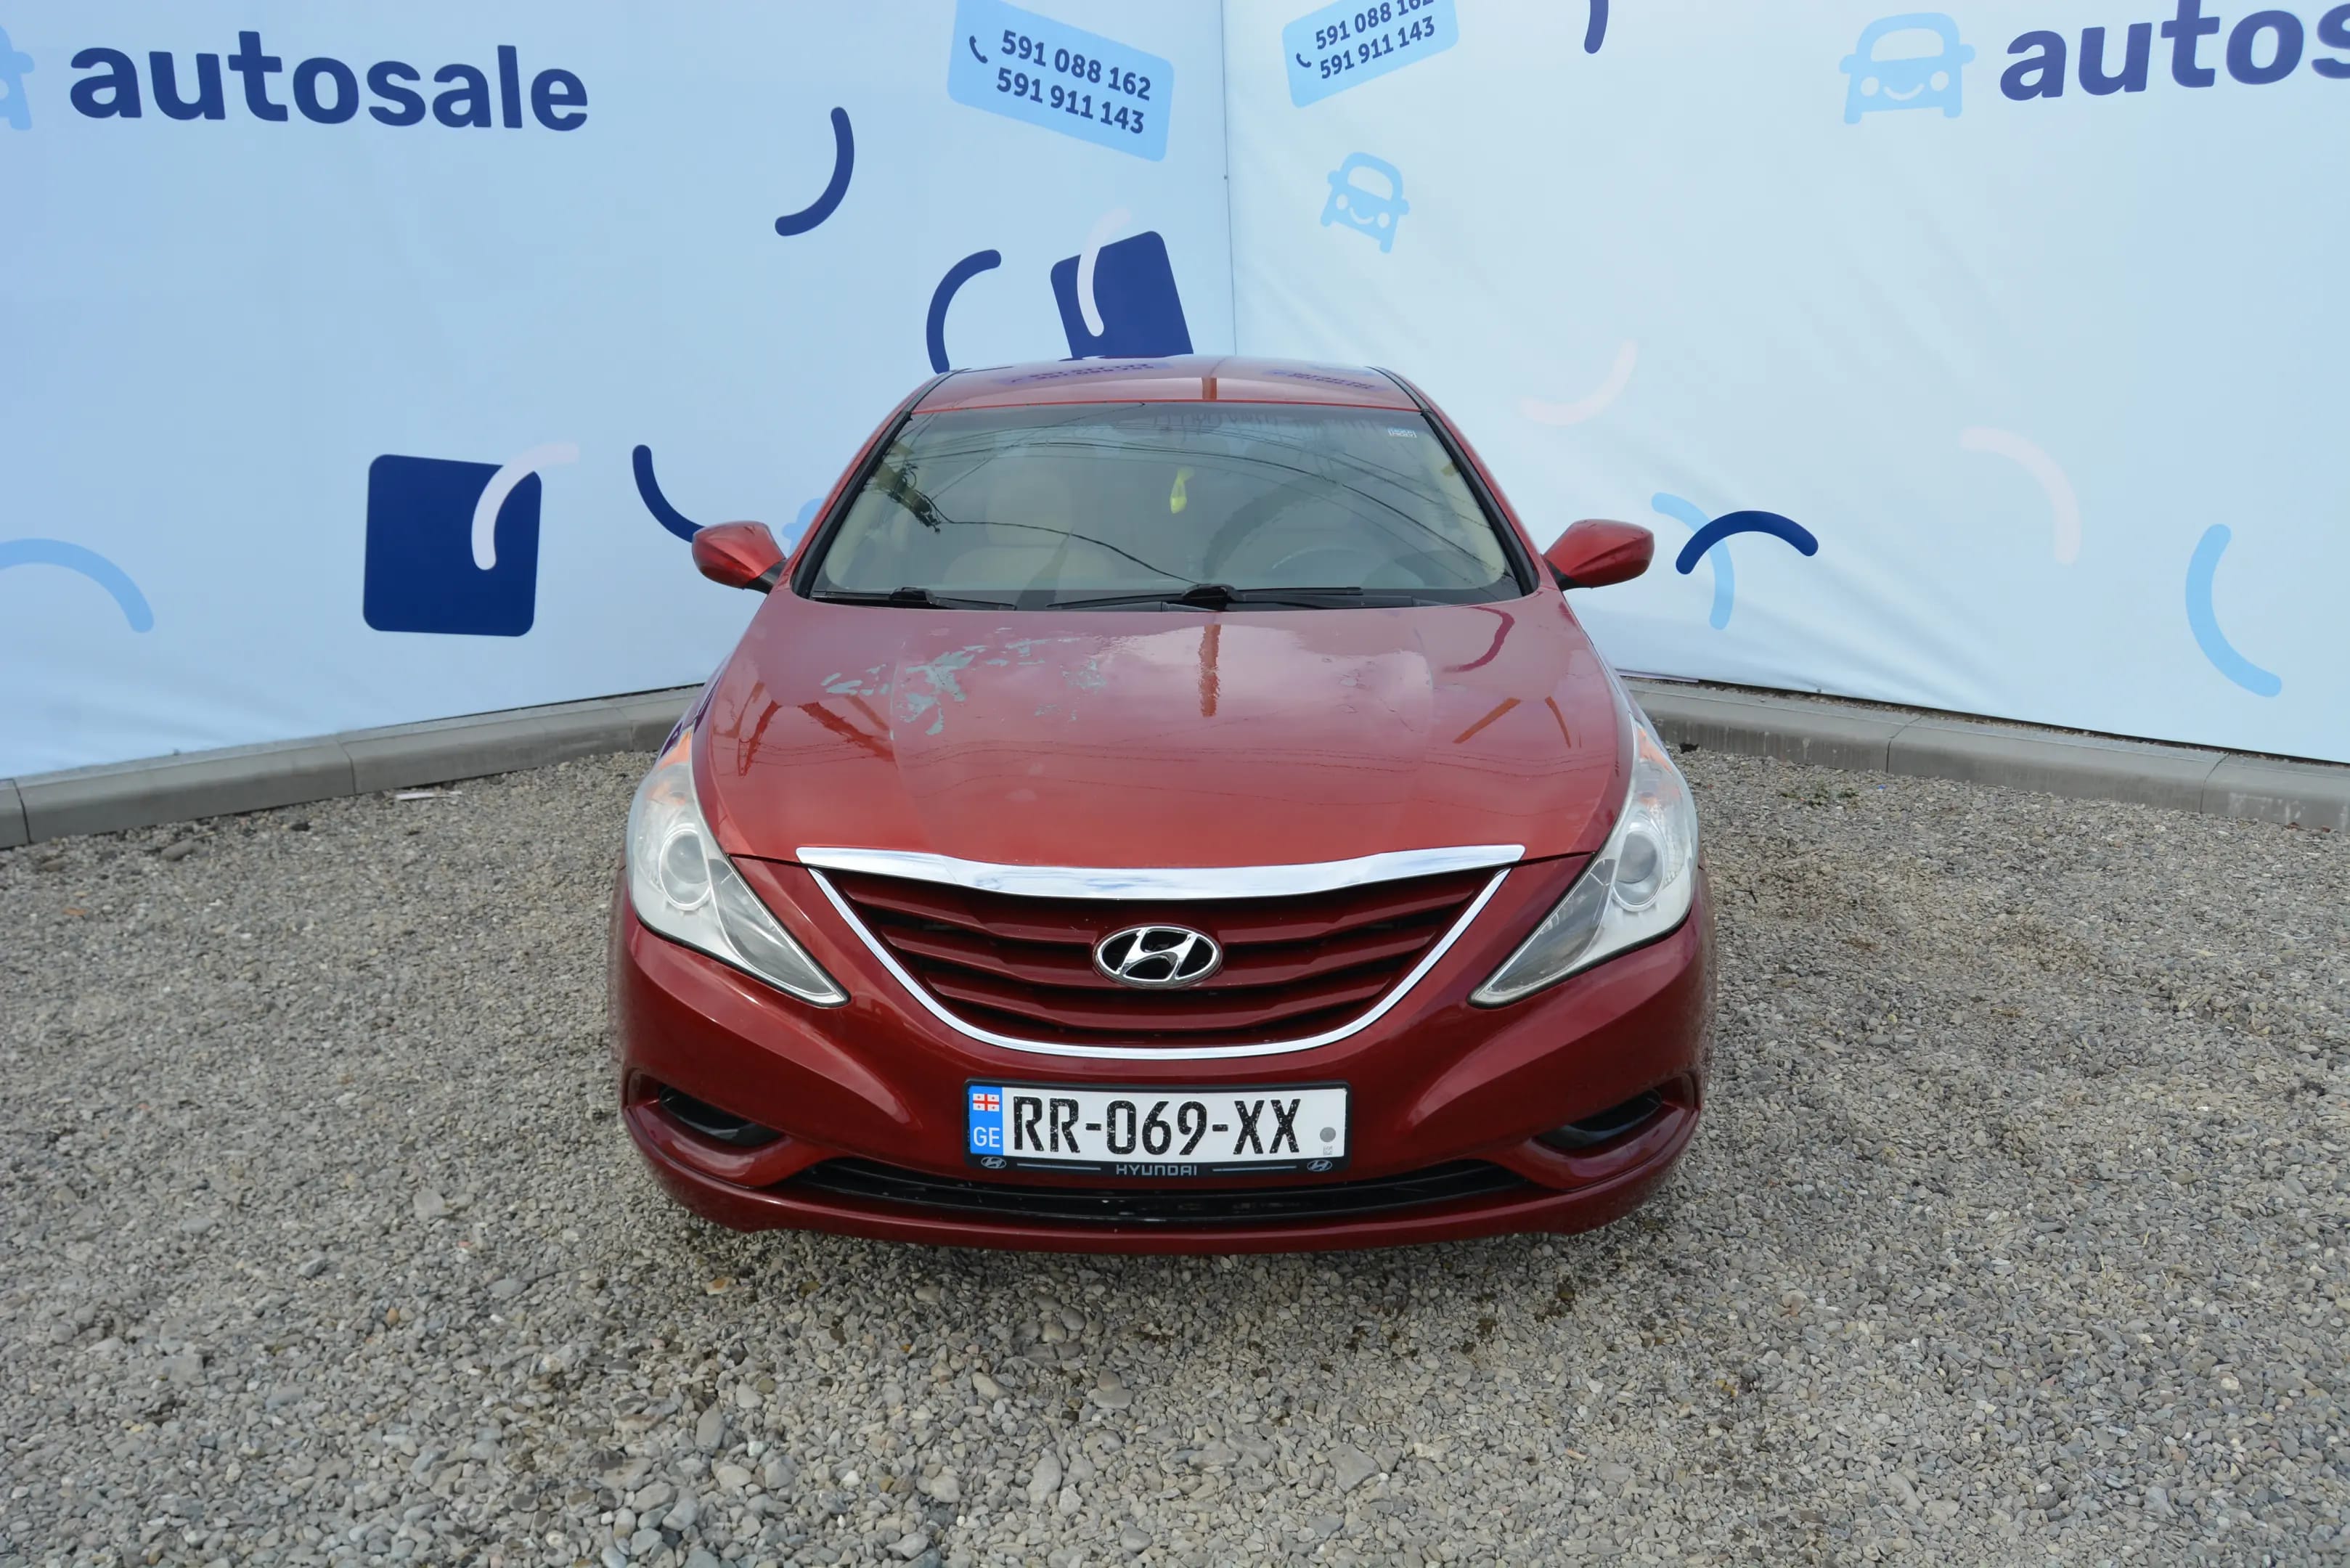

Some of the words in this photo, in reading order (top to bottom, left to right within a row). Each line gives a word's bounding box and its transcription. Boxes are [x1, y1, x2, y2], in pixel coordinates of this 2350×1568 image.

[1315, 20, 1350, 50] 591
[1355, 2, 1392, 33] 088
[1320, 49, 1355, 79] 591
[1358, 33, 1394, 64] 911
[1398, 15, 1435, 48] 143
[70, 30, 588, 131] autosale
[1001, 30, 1046, 68] 591
[1054, 48, 1101, 83] 088
[1108, 67, 1151, 101] 162
[996, 67, 1043, 104] 591
[1050, 85, 1093, 120] 911
[1100, 101, 1144, 134] 143
[973, 1127, 1000, 1148] GE
[1013, 1095, 1301, 1156] RR-069-XX
[1116, 1164, 1197, 1176] HYUNDAI
